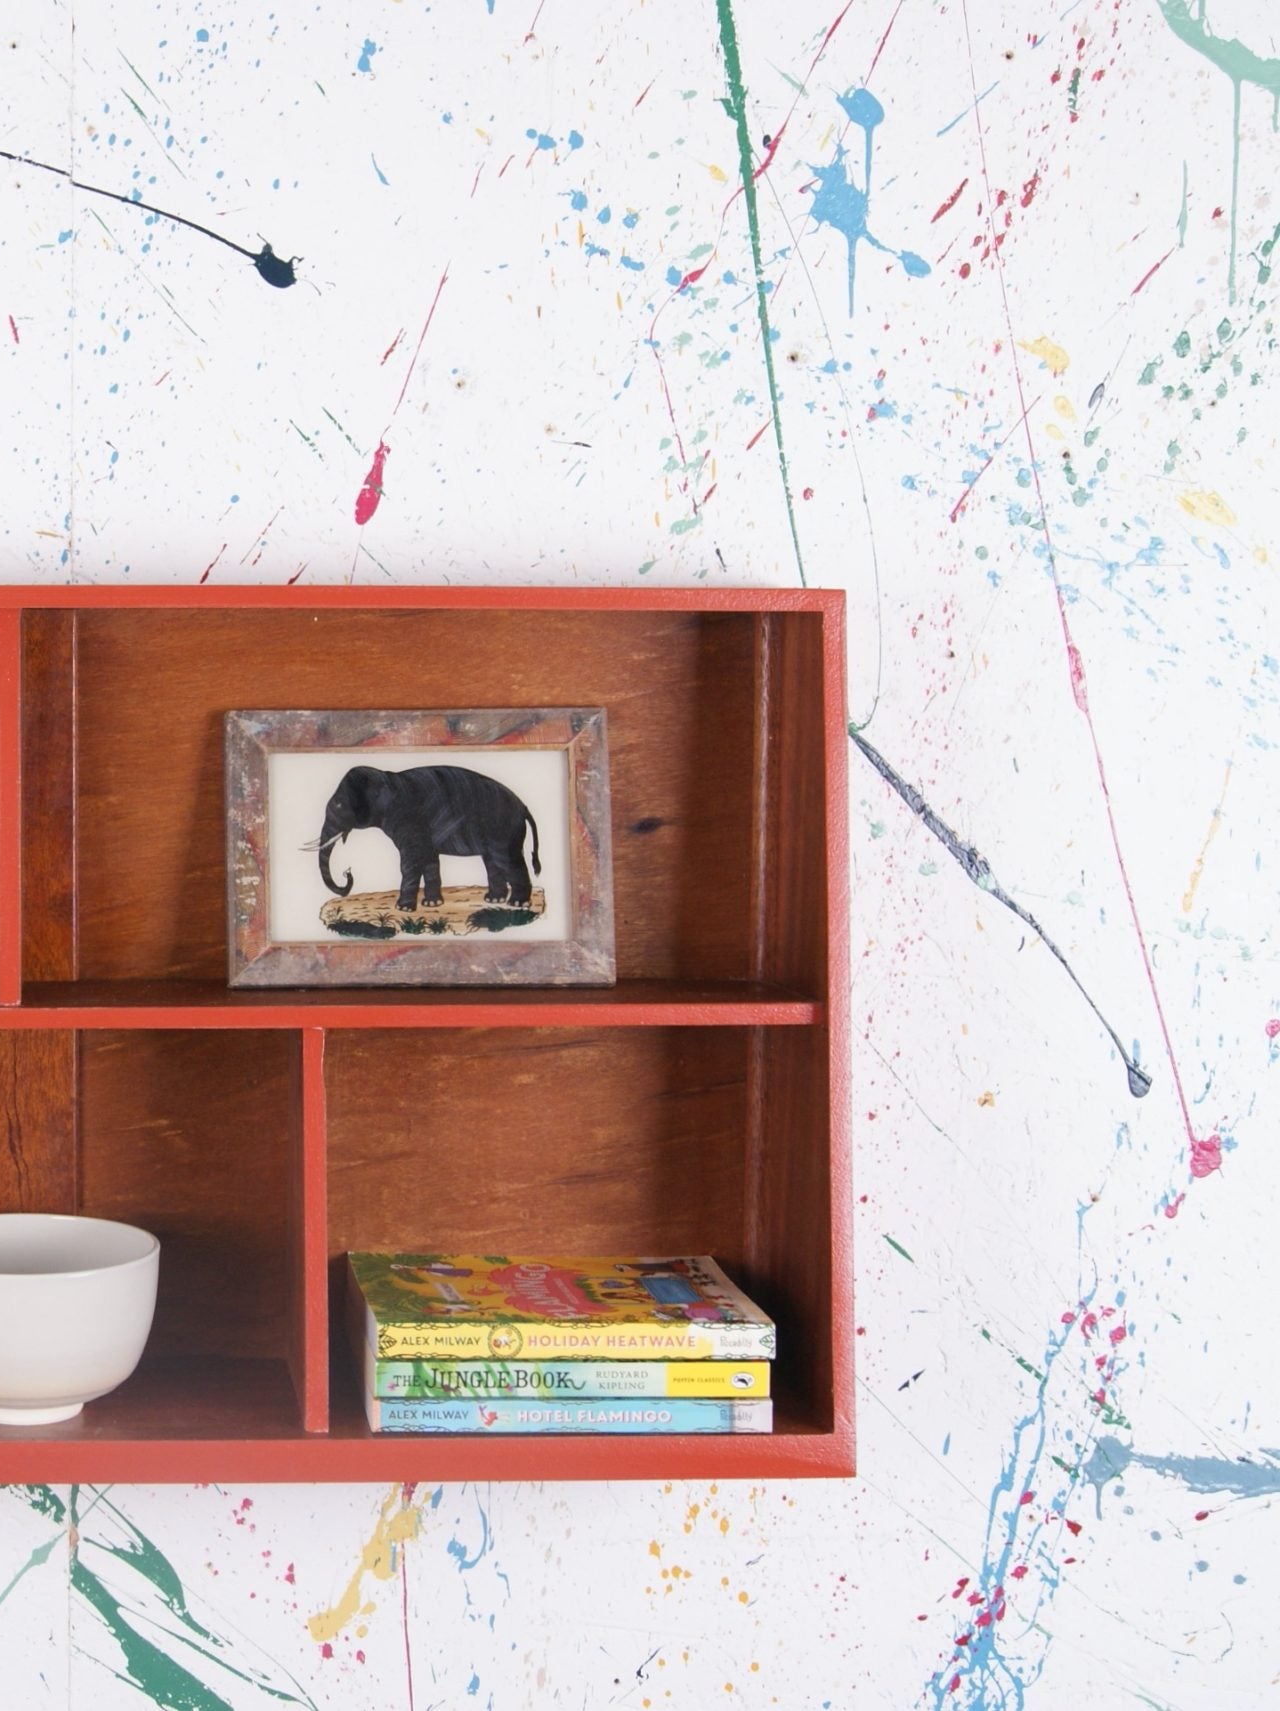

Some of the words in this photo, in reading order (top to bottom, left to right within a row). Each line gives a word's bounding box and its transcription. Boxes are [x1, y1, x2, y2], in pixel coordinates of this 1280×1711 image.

[401, 1336, 430, 1346] ALEX
[434, 1336, 481, 1346] MILWAY
[528, 1335, 601, 1348] HOLIDAY
[606, 1335, 697, 1348] HEATWAVE
[393, 1375, 420, 1387] THE
[424, 1368, 510, 1389] JUNGLE
[514, 1369, 586, 1390] BOOK
[596, 1371, 649, 1380] RUDYARD
[598, 1381, 646, 1391] KIPLING
[388, 1410, 418, 1420] ALEX
[422, 1410, 469, 1420] MILWAY
[516, 1409, 572, 1423] HOTEL
[577, 1409, 672, 1424] FLAMINGO
